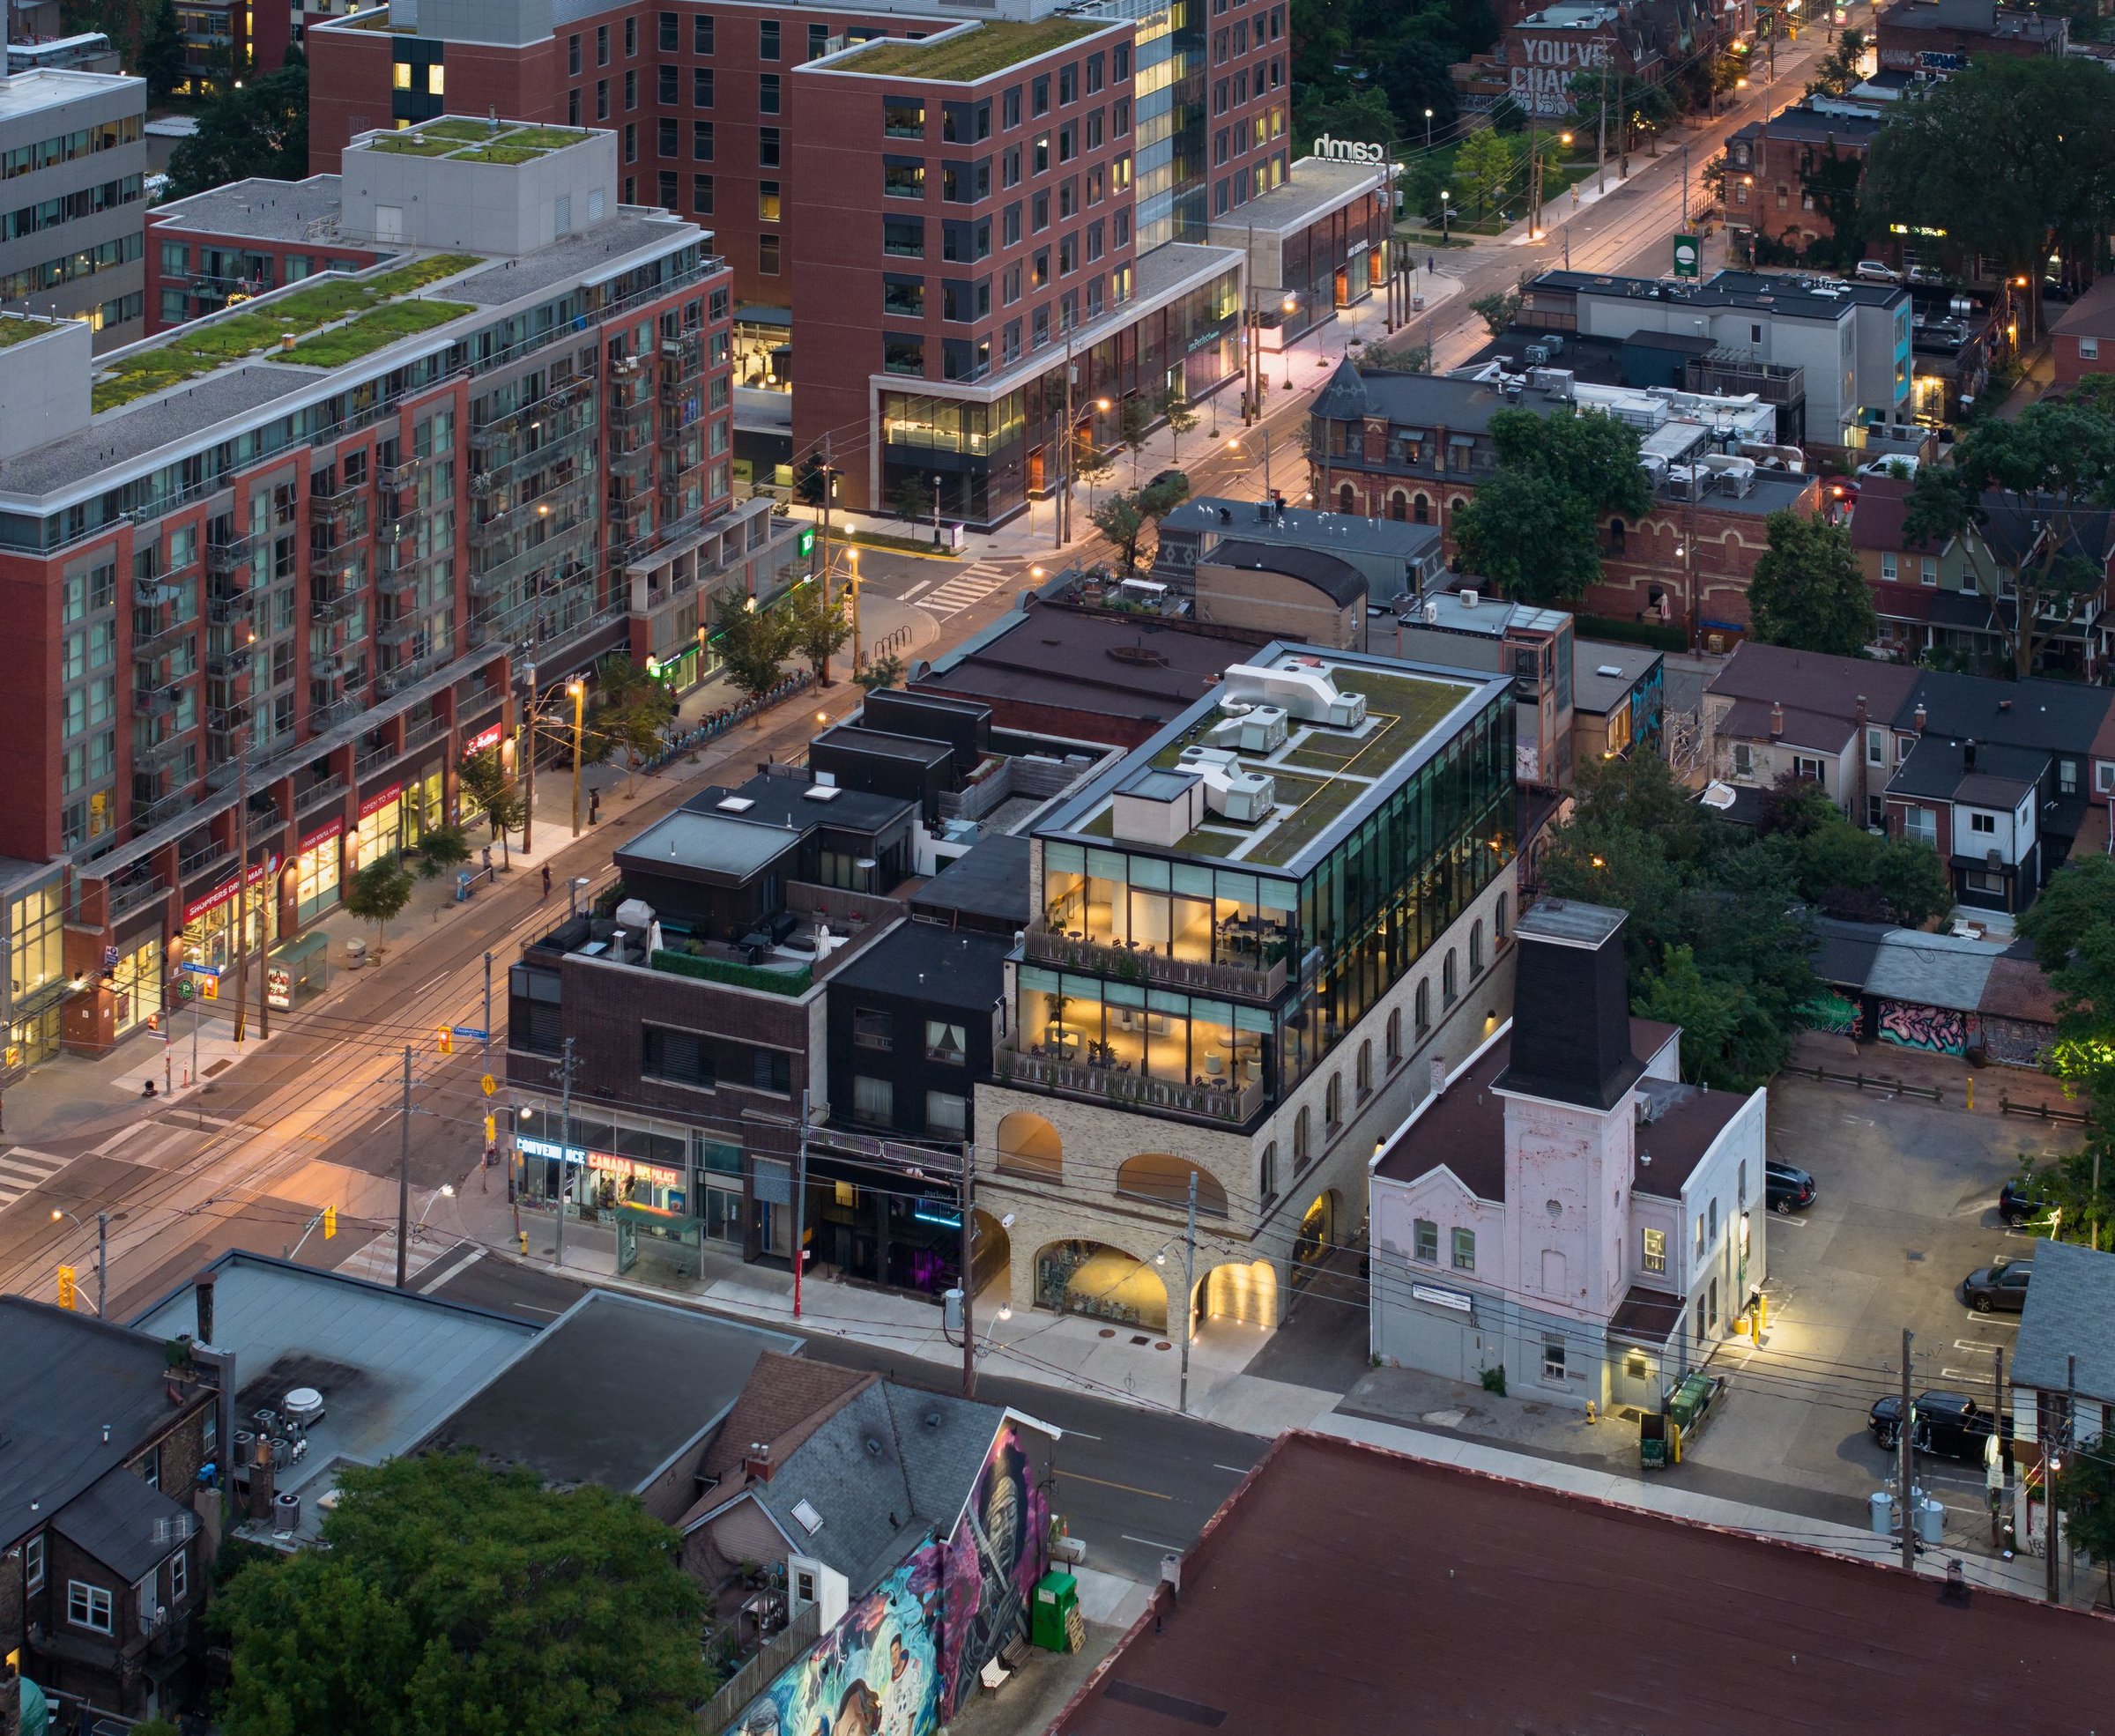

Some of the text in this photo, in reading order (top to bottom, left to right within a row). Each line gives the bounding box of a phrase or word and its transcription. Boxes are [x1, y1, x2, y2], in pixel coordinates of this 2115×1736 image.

[1523, 39, 1607, 67] YOU'VE
[1511, 67, 1576, 94] CHAN
[802, 535, 813, 551] TD
[362, 799, 378, 813] OPEN
[378, 795, 387, 804] TO
[305, 837, 316, 847] FOOD
[189, 867, 263, 916] SHOPPERS DR MAR
[516, 1138, 585, 1164] CONVENINCE
[588, 1153, 632, 1175] CANADA
[651, 1168, 677, 1184] PALACE
[1470, 1319, 1480, 1329] 16
